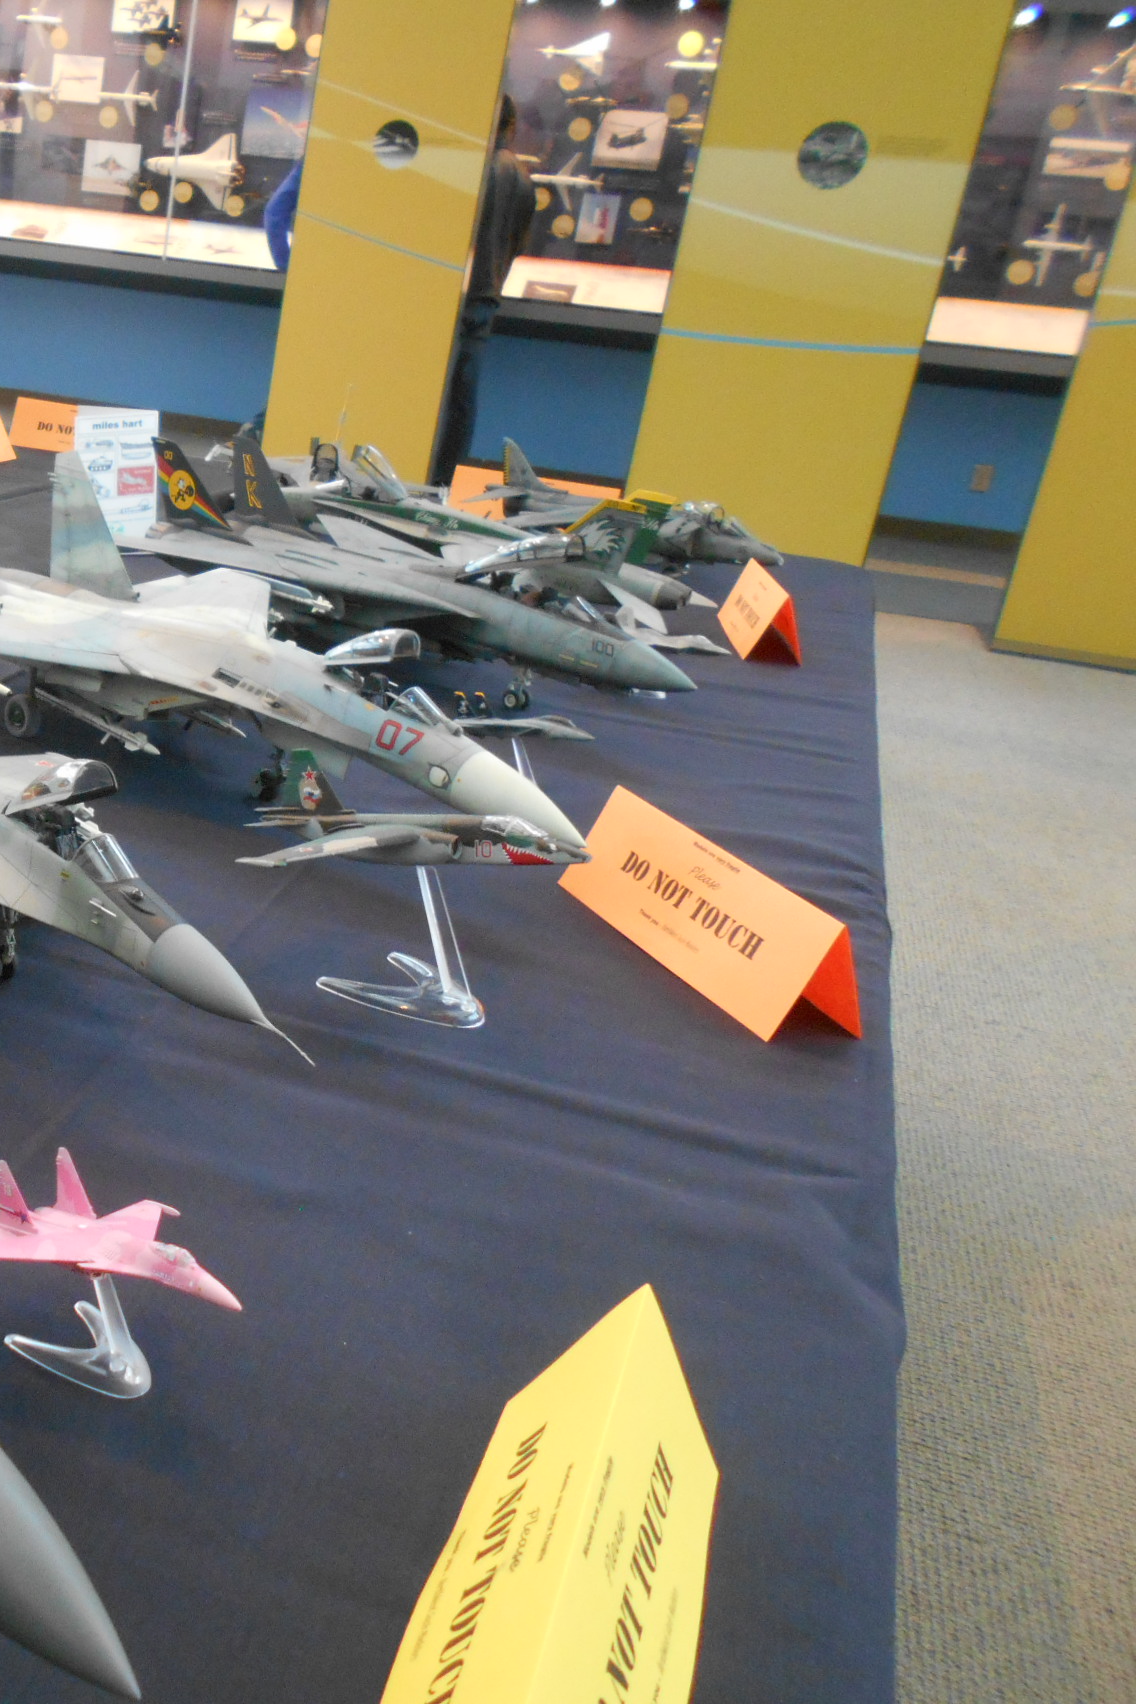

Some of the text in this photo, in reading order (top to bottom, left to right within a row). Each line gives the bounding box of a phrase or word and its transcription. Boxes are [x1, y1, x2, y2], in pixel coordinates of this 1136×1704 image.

[37, 421, 53, 432] DO
[92, 419, 143, 430] miles hart
[375, 719, 425, 756] 07
[475, 840, 493, 858] 10
[688, 866, 721, 891] Please
[619, 850, 651, 882] DO
[647, 868, 693, 910] NOT
[689, 896, 765, 960] TOUCH
[507, 1421, 548, 1480] DO
[474, 1478, 528, 1565] NOT
[509, 1506, 540, 1573] Please
[606, 1583, 643, 1704] NOT
[630, 1441, 673, 1600] TOUCH
